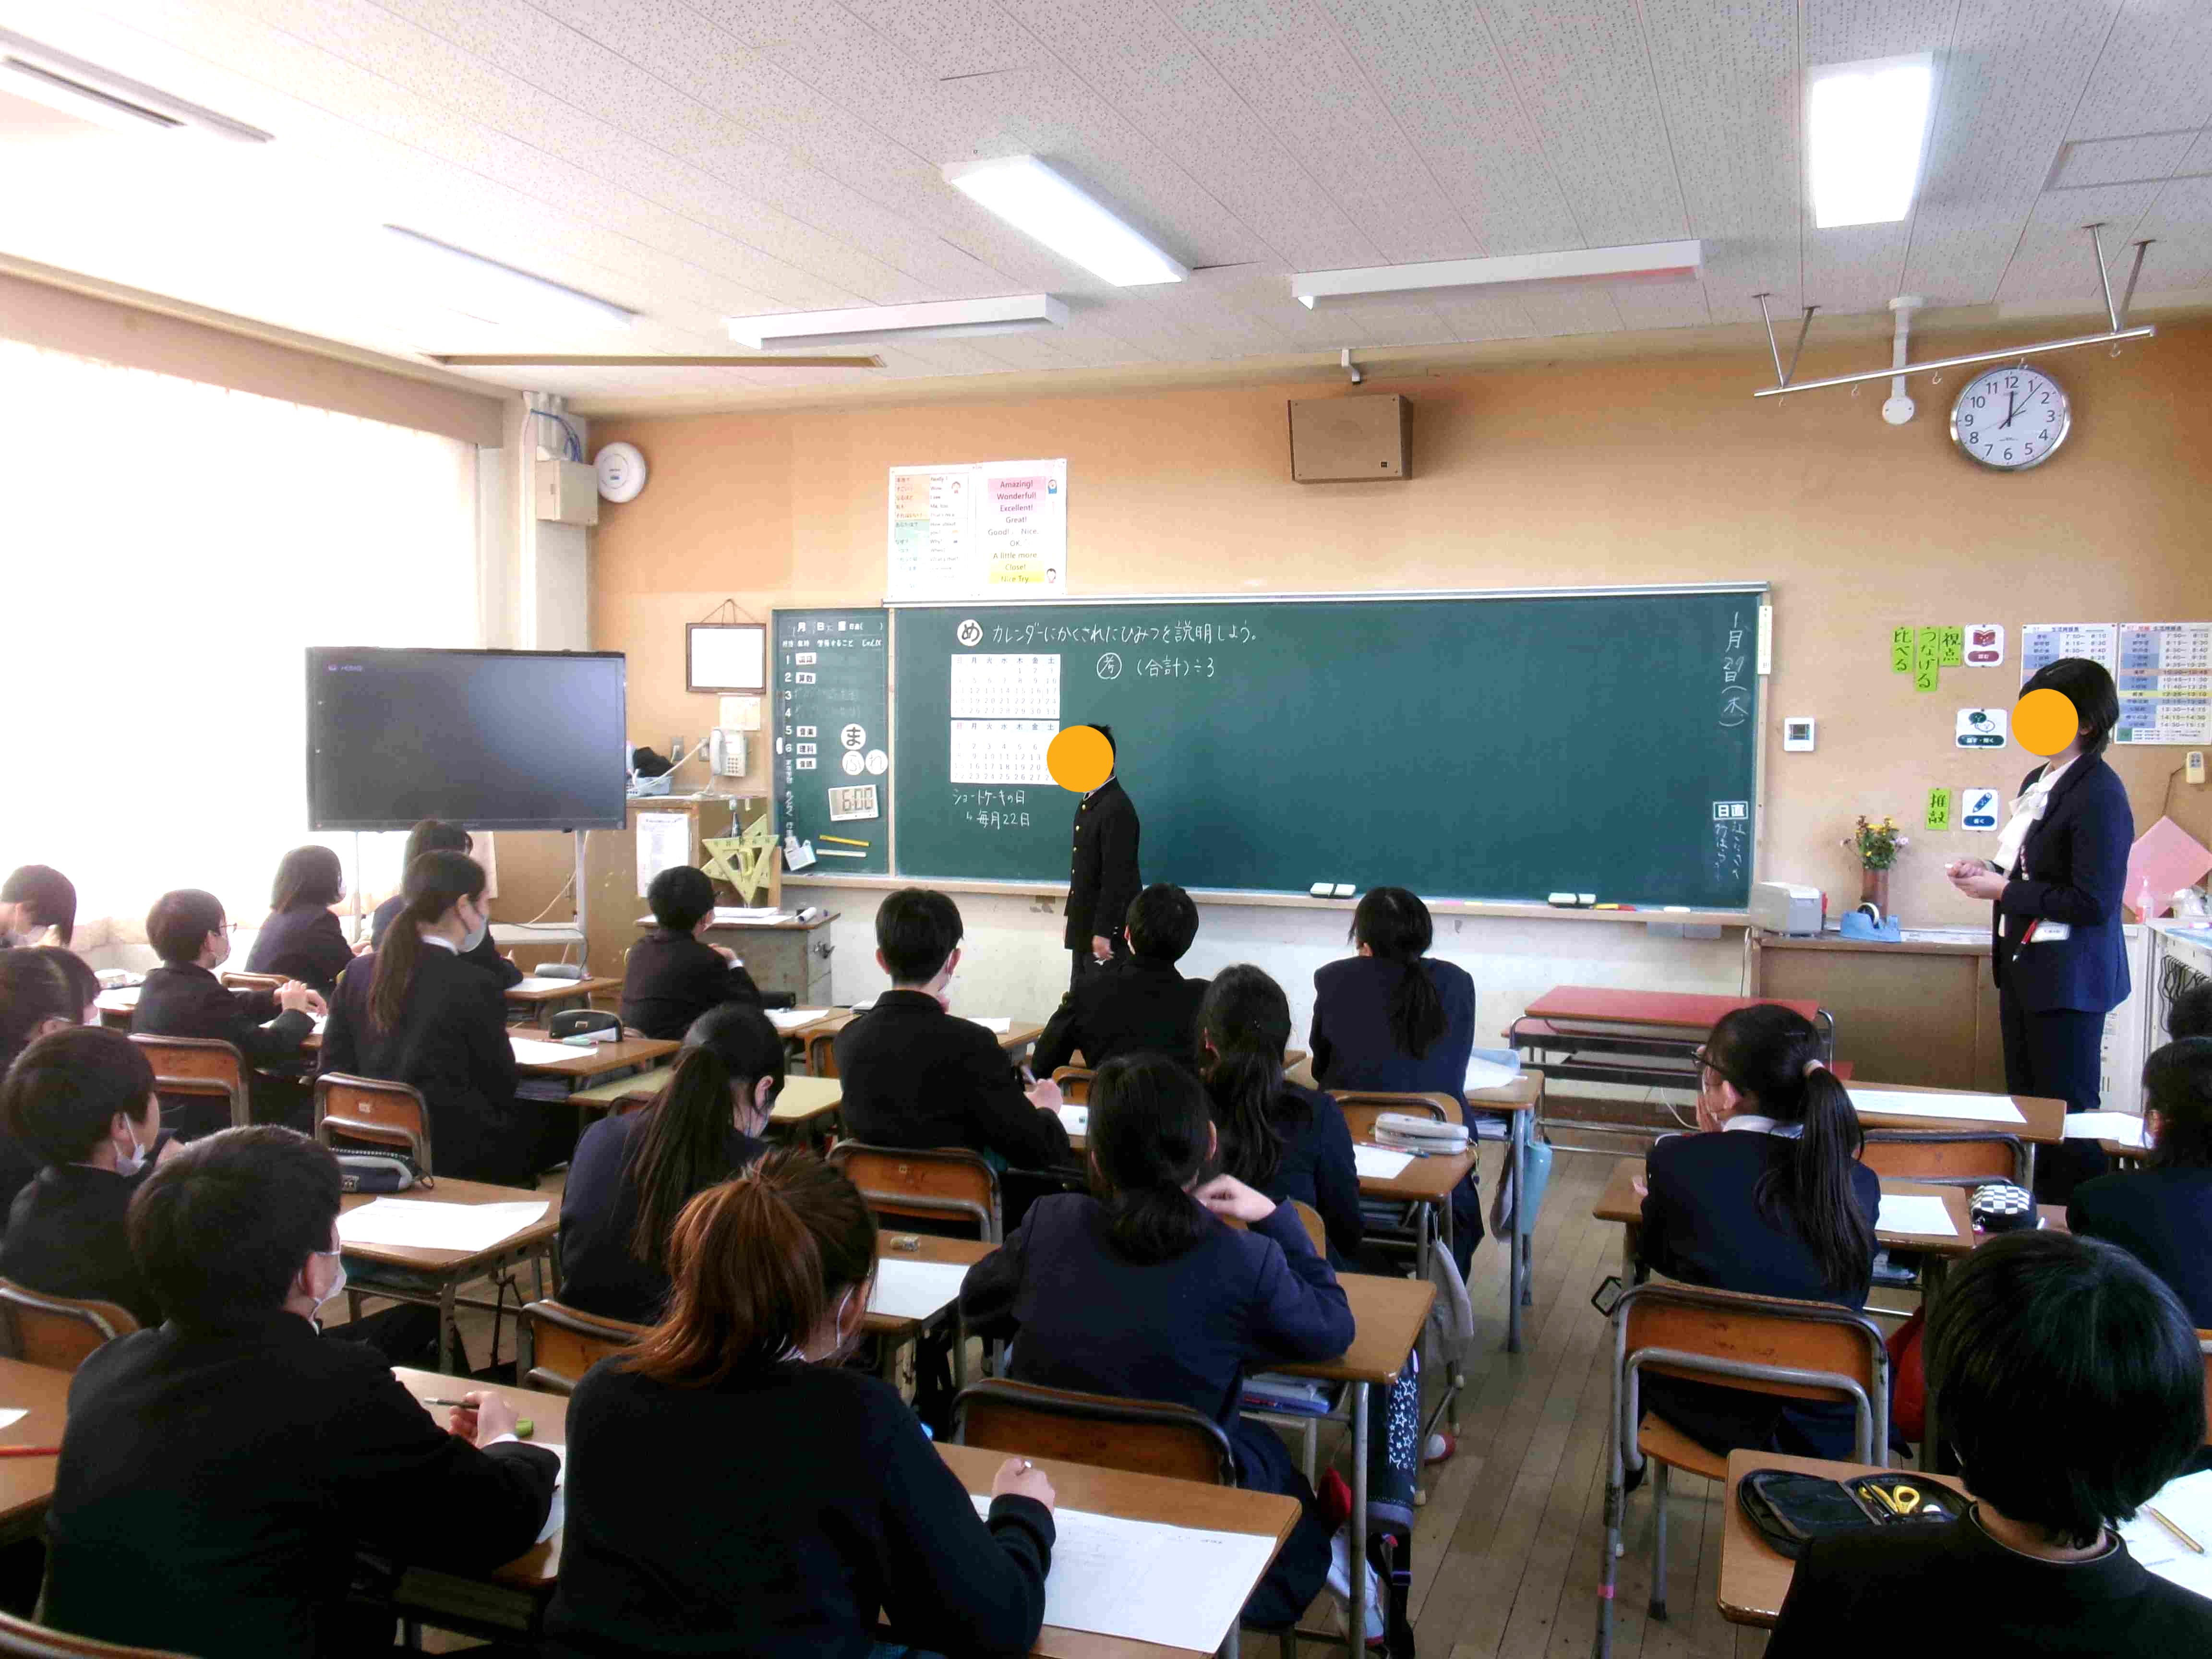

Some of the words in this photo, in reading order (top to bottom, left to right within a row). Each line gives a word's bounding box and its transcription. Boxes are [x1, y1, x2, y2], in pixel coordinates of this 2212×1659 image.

[1986, 382, 1998, 394] 11
[2004, 376, 2019, 388] 12
[2029, 380, 2033, 392] 1
[1971, 396, 1985, 408] 10
[2041, 392, 2050, 404] 2
[1965, 414, 1973, 427] 9
[2046, 410, 2055, 422] 3
[1970, 432, 1979, 444] 8
[2038, 429, 2048, 441] 4
[1984, 444, 1993, 456] 7
[2004, 447, 2013, 460] 6
[2024, 443, 2033, 455] 5
[1000, 480, 1033, 489] Amazing!
[997, 492, 1036, 500] Wonderful!
[1000, 504, 1033, 512] Excellent!
[817, 622, 824, 631] 日
[961, 622, 980, 642] め
[1894, 630, 1911, 671] 比べる
[1942, 632, 1960, 661] 視点
[786, 655, 790, 664] 1
[1918, 631, 1936, 688] つなげる
[785, 673, 792, 682] 2
[799, 674, 813, 682] 算数
[785, 690, 791, 700] 3
[785, 708, 791, 718] 4
[785, 725, 792, 734] 5
[800, 728, 814, 736] 音楽
[846, 727, 861, 746] ま
[785, 744, 792, 753] 6
[799, 745, 814, 753] 理科
[846, 755, 861, 772] ふ
[869, 754, 884, 771] れ
[1719, 805, 1744, 817] 日直
